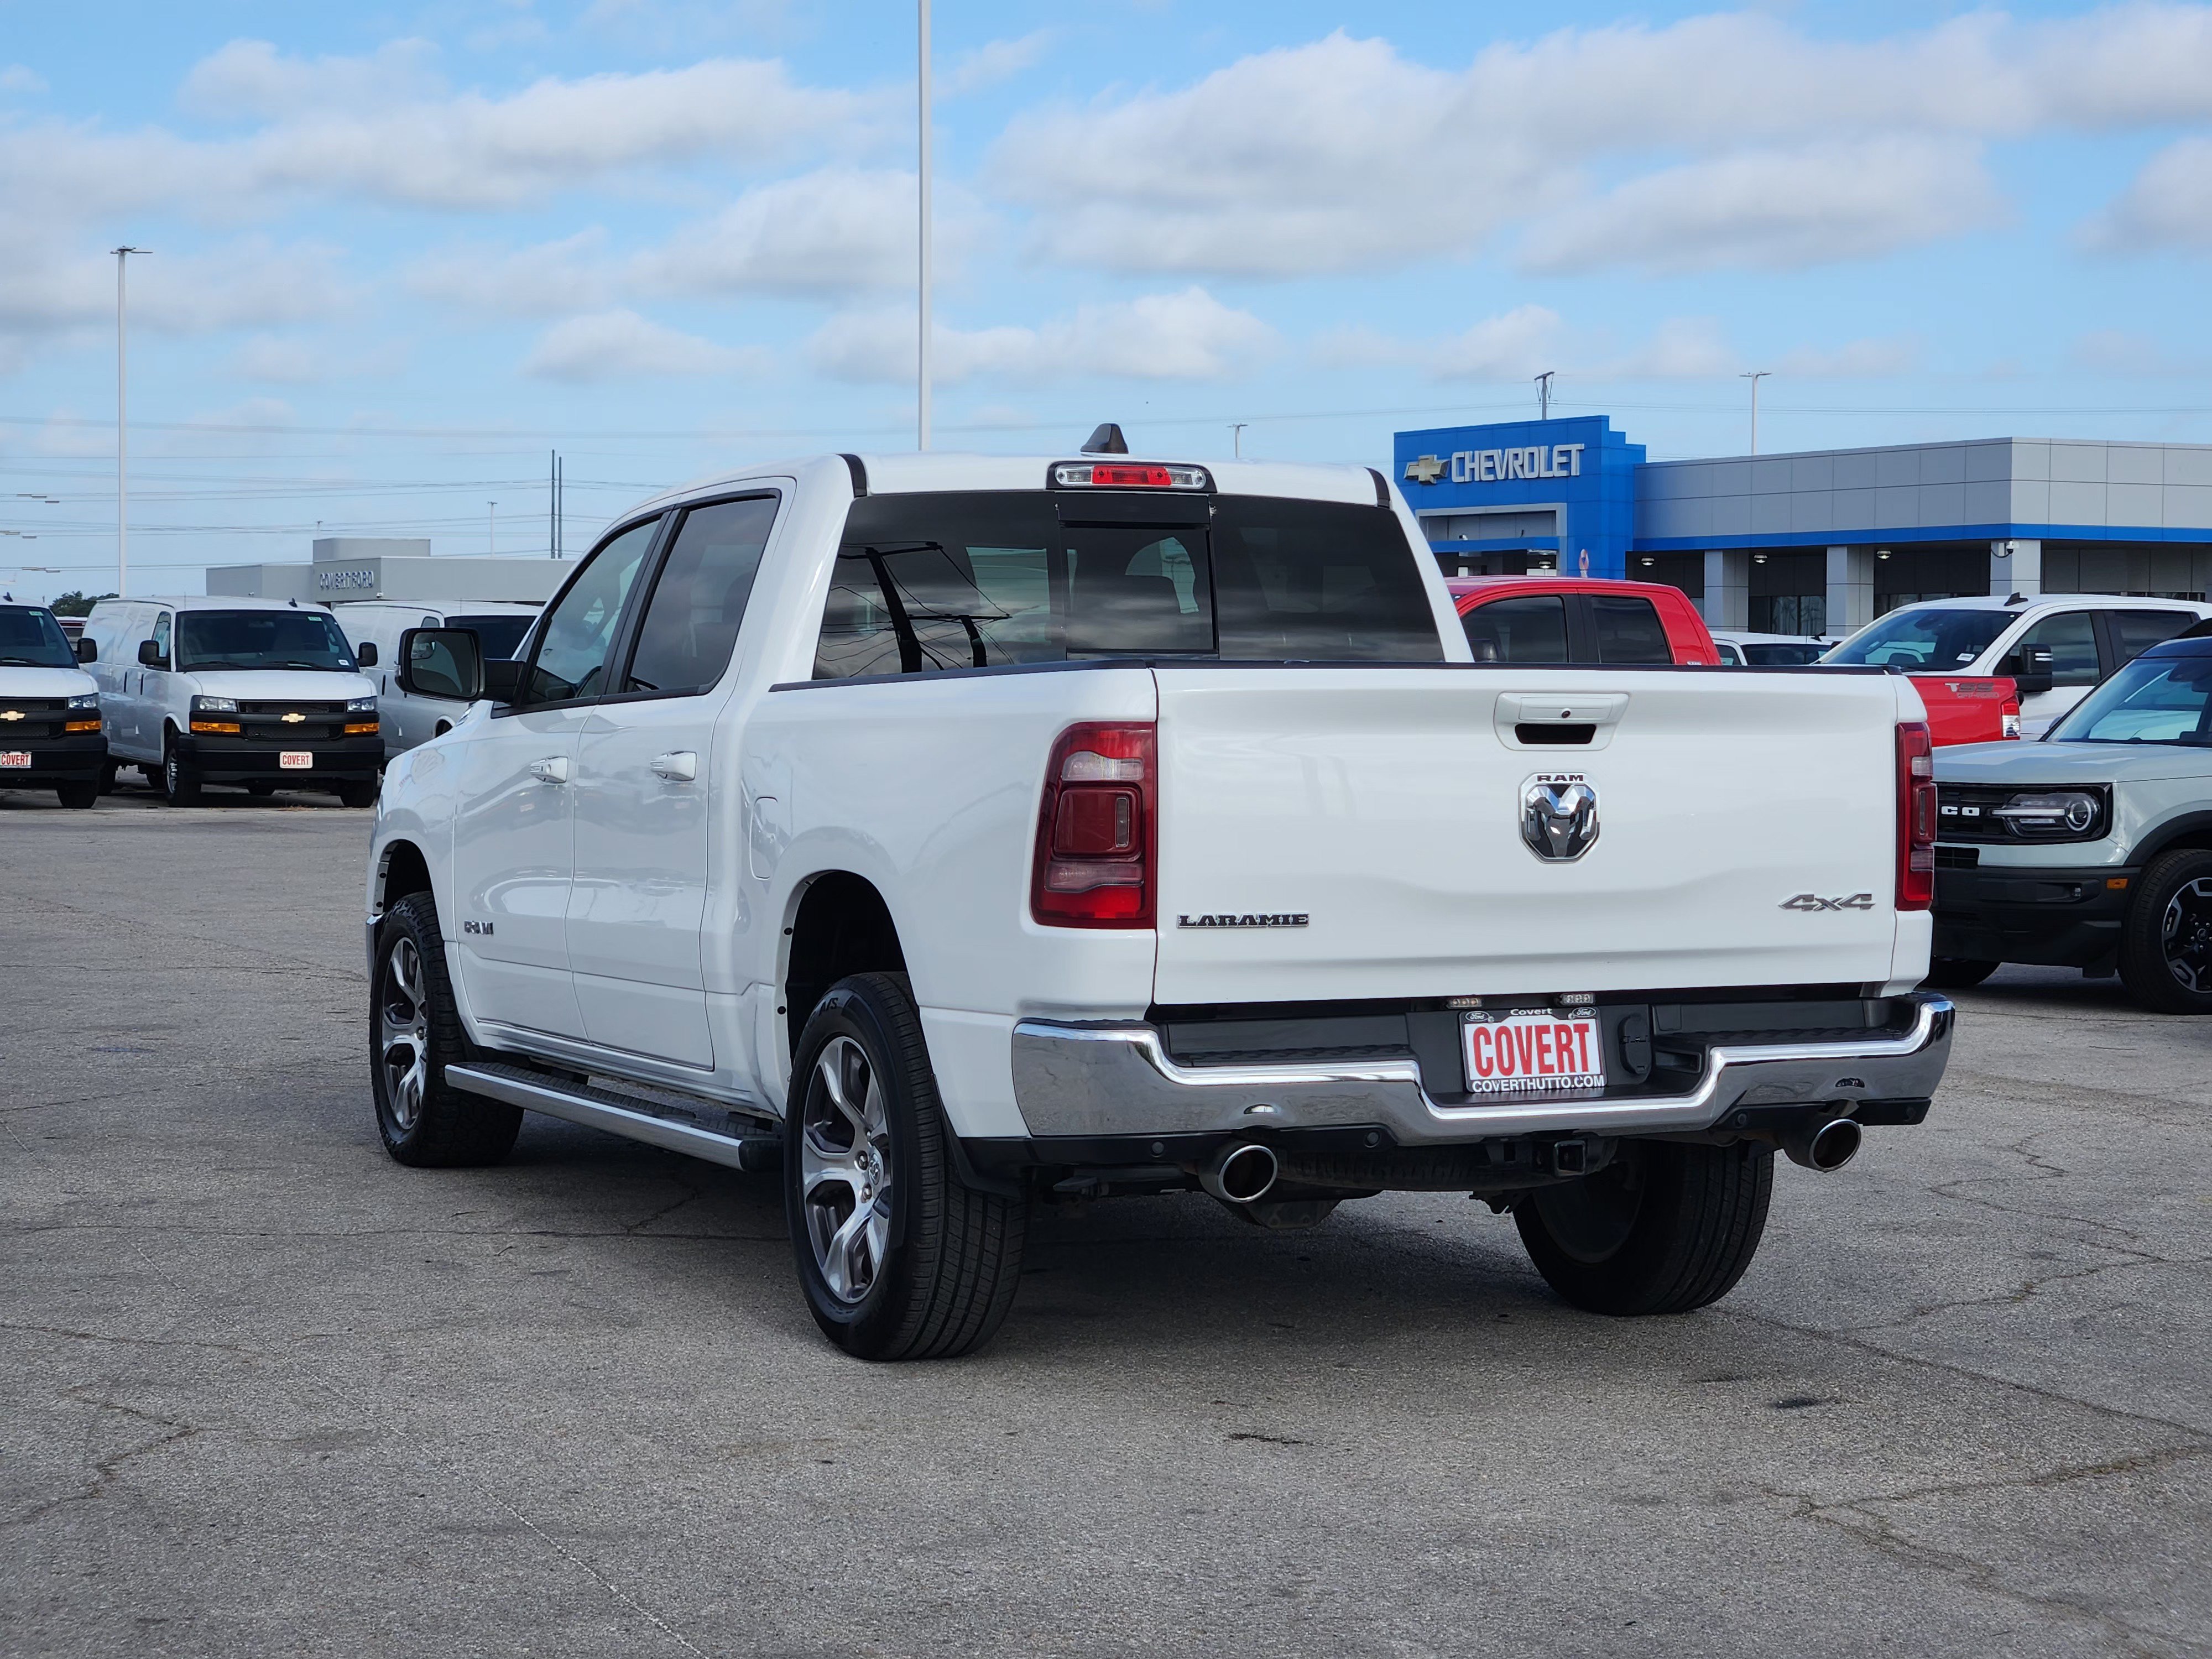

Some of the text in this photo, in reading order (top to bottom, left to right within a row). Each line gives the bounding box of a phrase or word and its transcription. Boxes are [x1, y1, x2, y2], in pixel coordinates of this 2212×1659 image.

[1451, 443, 1585, 483] CHEVROLET
[320, 571, 374, 589] COVERT FORD
[1, 754, 29, 765] COVERT
[282, 754, 310, 765] COVERT
[1177, 912, 1309, 928] LARAMIE
[1510, 1008, 1553, 1016] Covert
[1473, 1023, 1590, 1077] COVERT
[1472, 1075, 1604, 1093] COVERTHUTTO.COM
